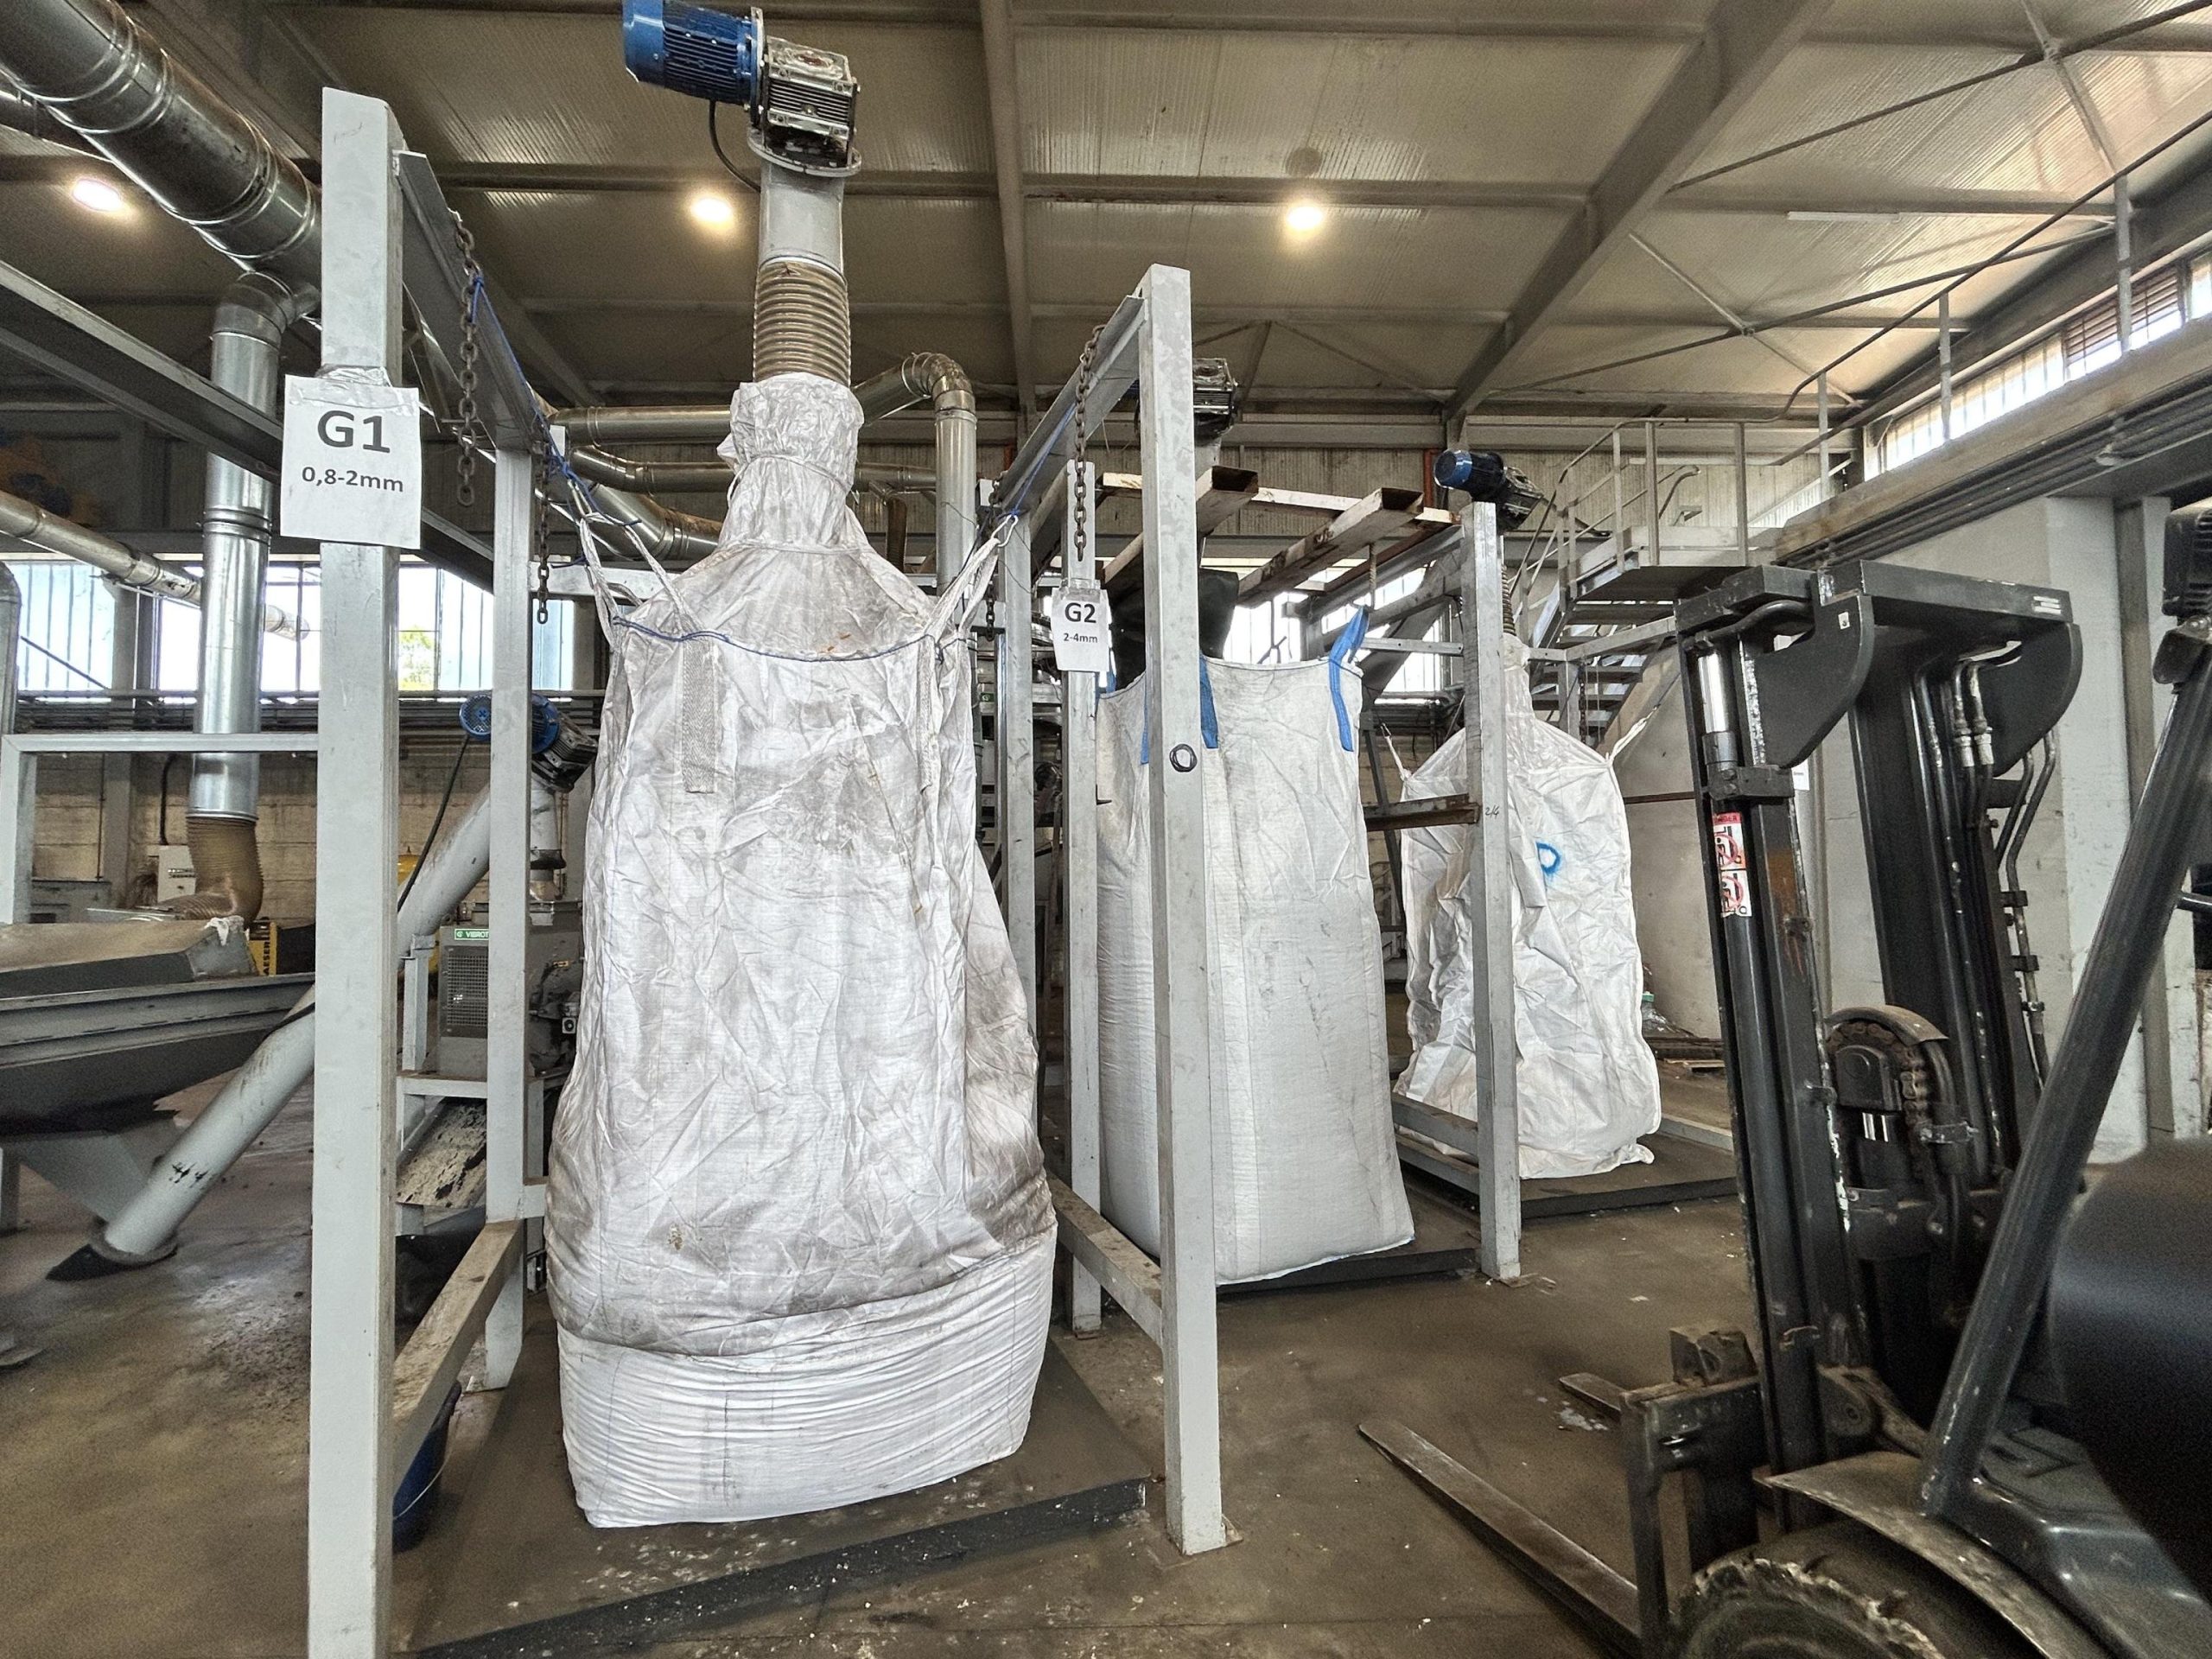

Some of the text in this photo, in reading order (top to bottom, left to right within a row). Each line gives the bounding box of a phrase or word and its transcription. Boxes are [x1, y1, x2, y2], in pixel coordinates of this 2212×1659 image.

[317, 410, 391, 454] G1
[302, 467, 404, 493] 0,8-2mm
[1065, 602, 1096, 623] G2
[1063, 632, 1098, 643] 2-4mm
